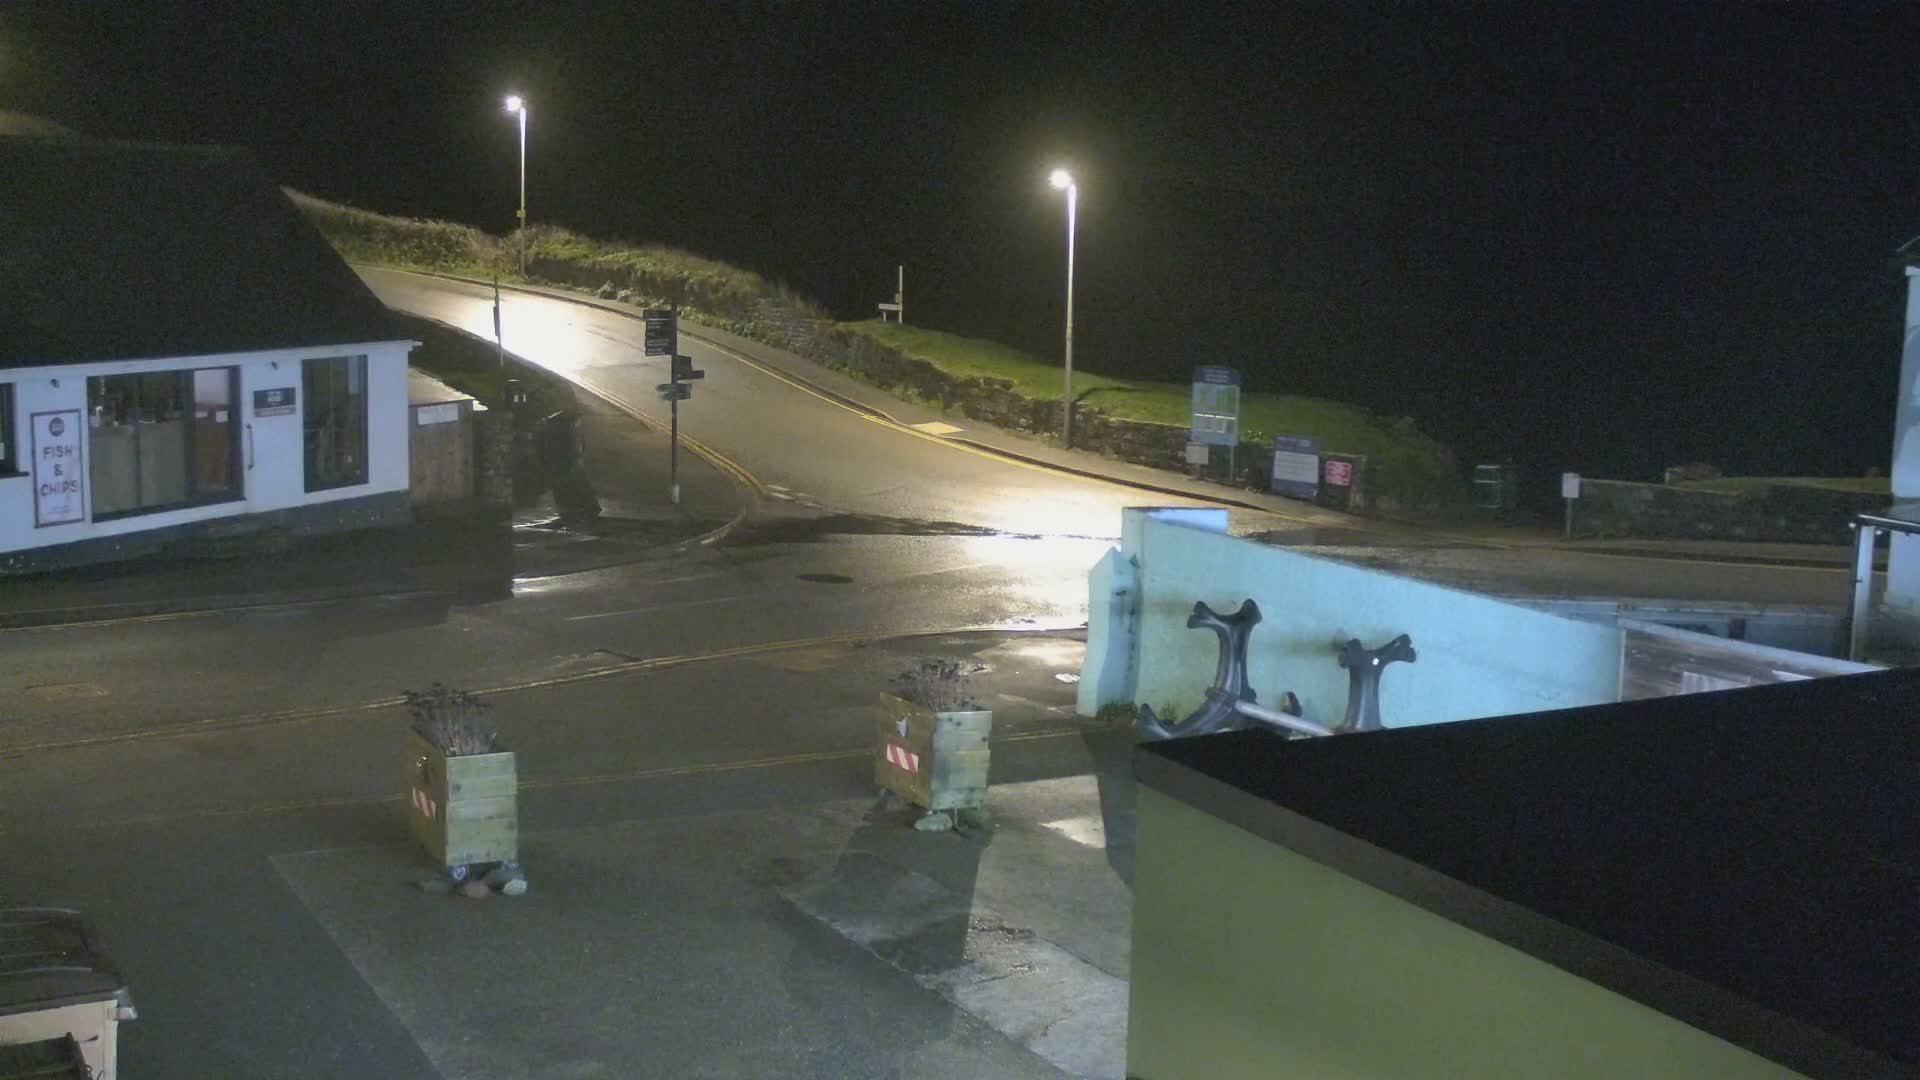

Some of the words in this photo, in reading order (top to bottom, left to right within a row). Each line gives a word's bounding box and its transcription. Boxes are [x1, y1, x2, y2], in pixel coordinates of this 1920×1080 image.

[43, 445, 72, 459] FISH
[54, 463, 63, 476] &
[40, 480, 77, 496] CHIPS
